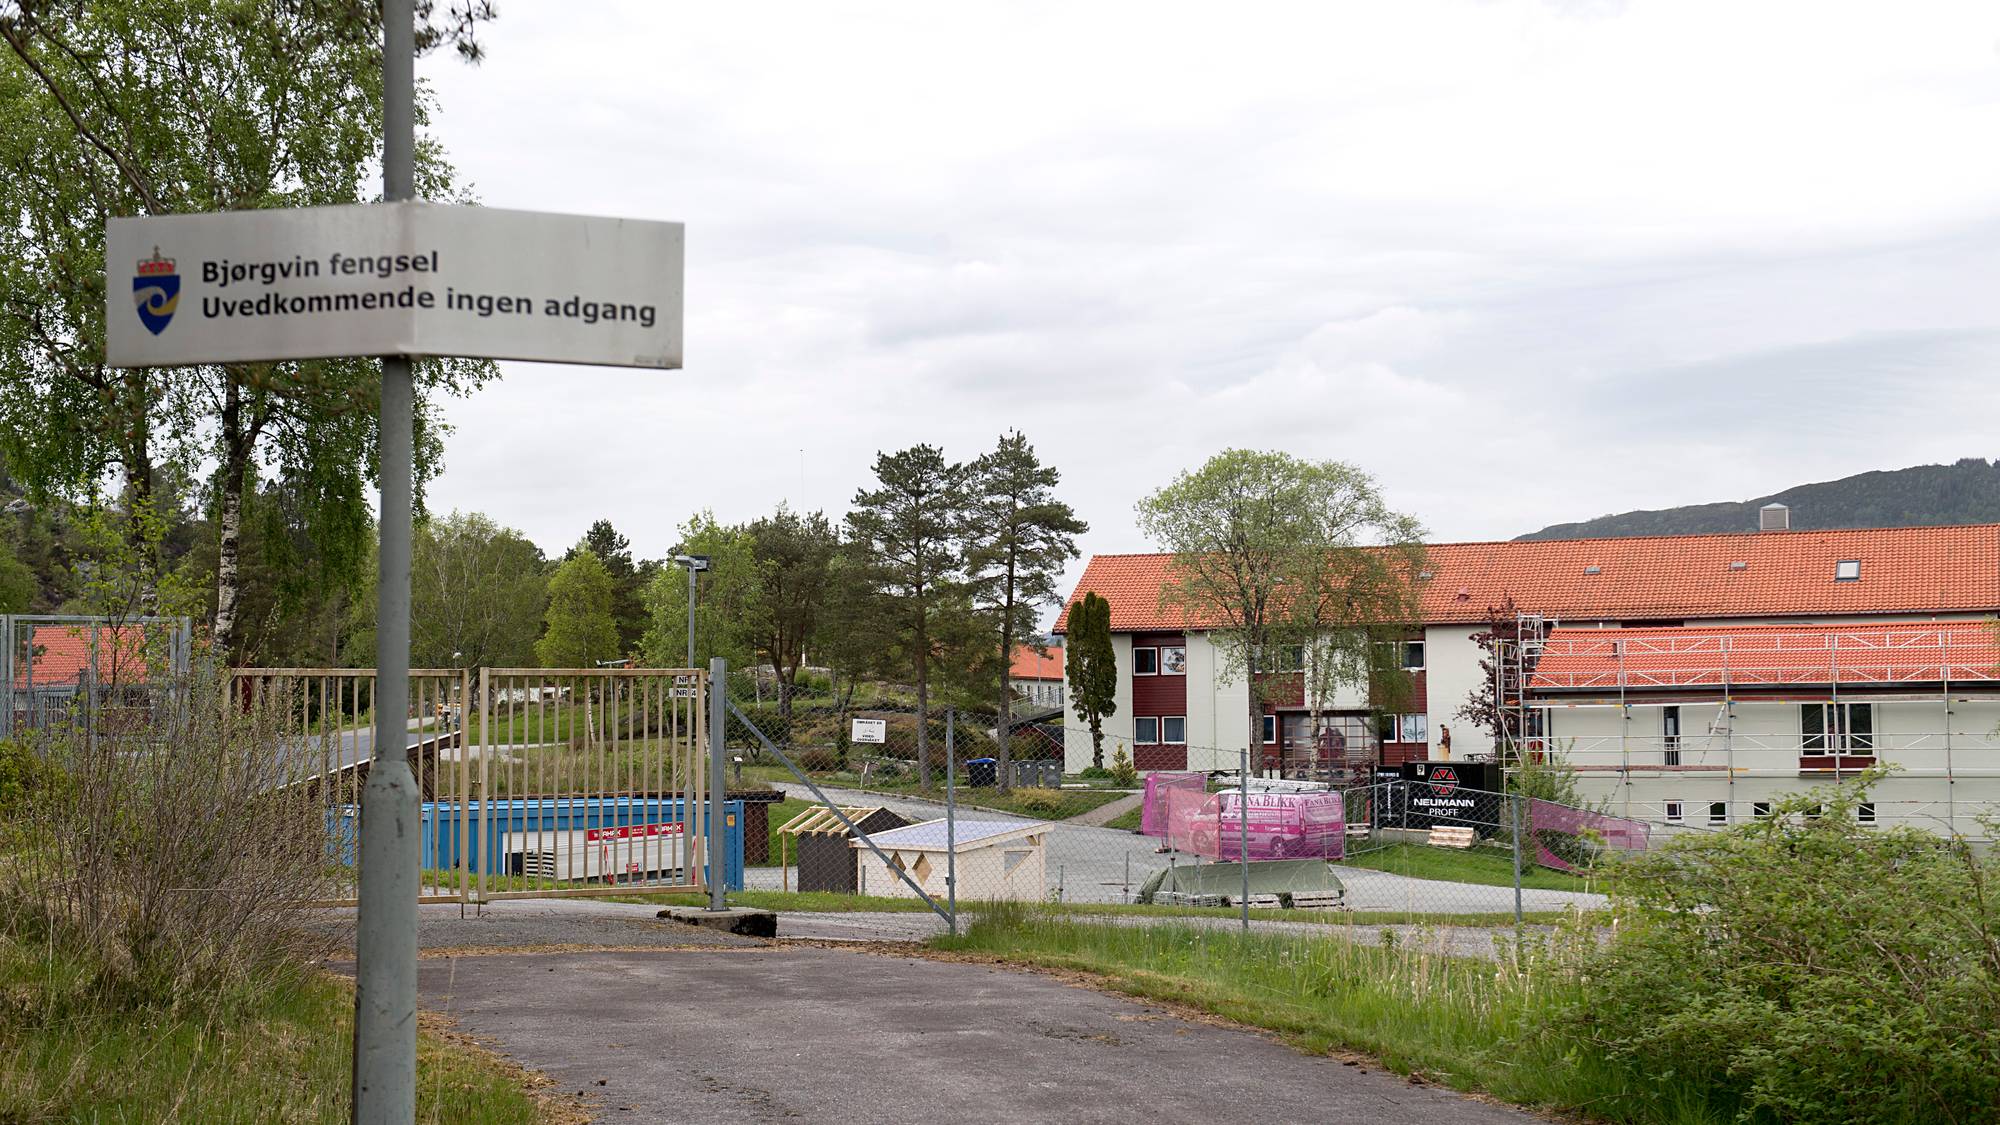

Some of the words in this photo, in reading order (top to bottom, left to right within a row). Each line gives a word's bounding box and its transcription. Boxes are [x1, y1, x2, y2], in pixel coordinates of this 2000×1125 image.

[202, 256, 320, 288] Bjørgvin
[330, 251, 438, 278] fengsel
[202, 286, 435, 318] Uvedkommende
[447, 287, 533, 317] ingen
[544, 296, 656, 328] adgang
[1234, 794, 1260, 807] FNA
[1263, 794, 1296, 807] BLIKK
[1305, 798, 1323, 806] FANA
[1413, 798, 1475, 807] NEUMANN
[1429, 808, 1459, 816] PROFF
